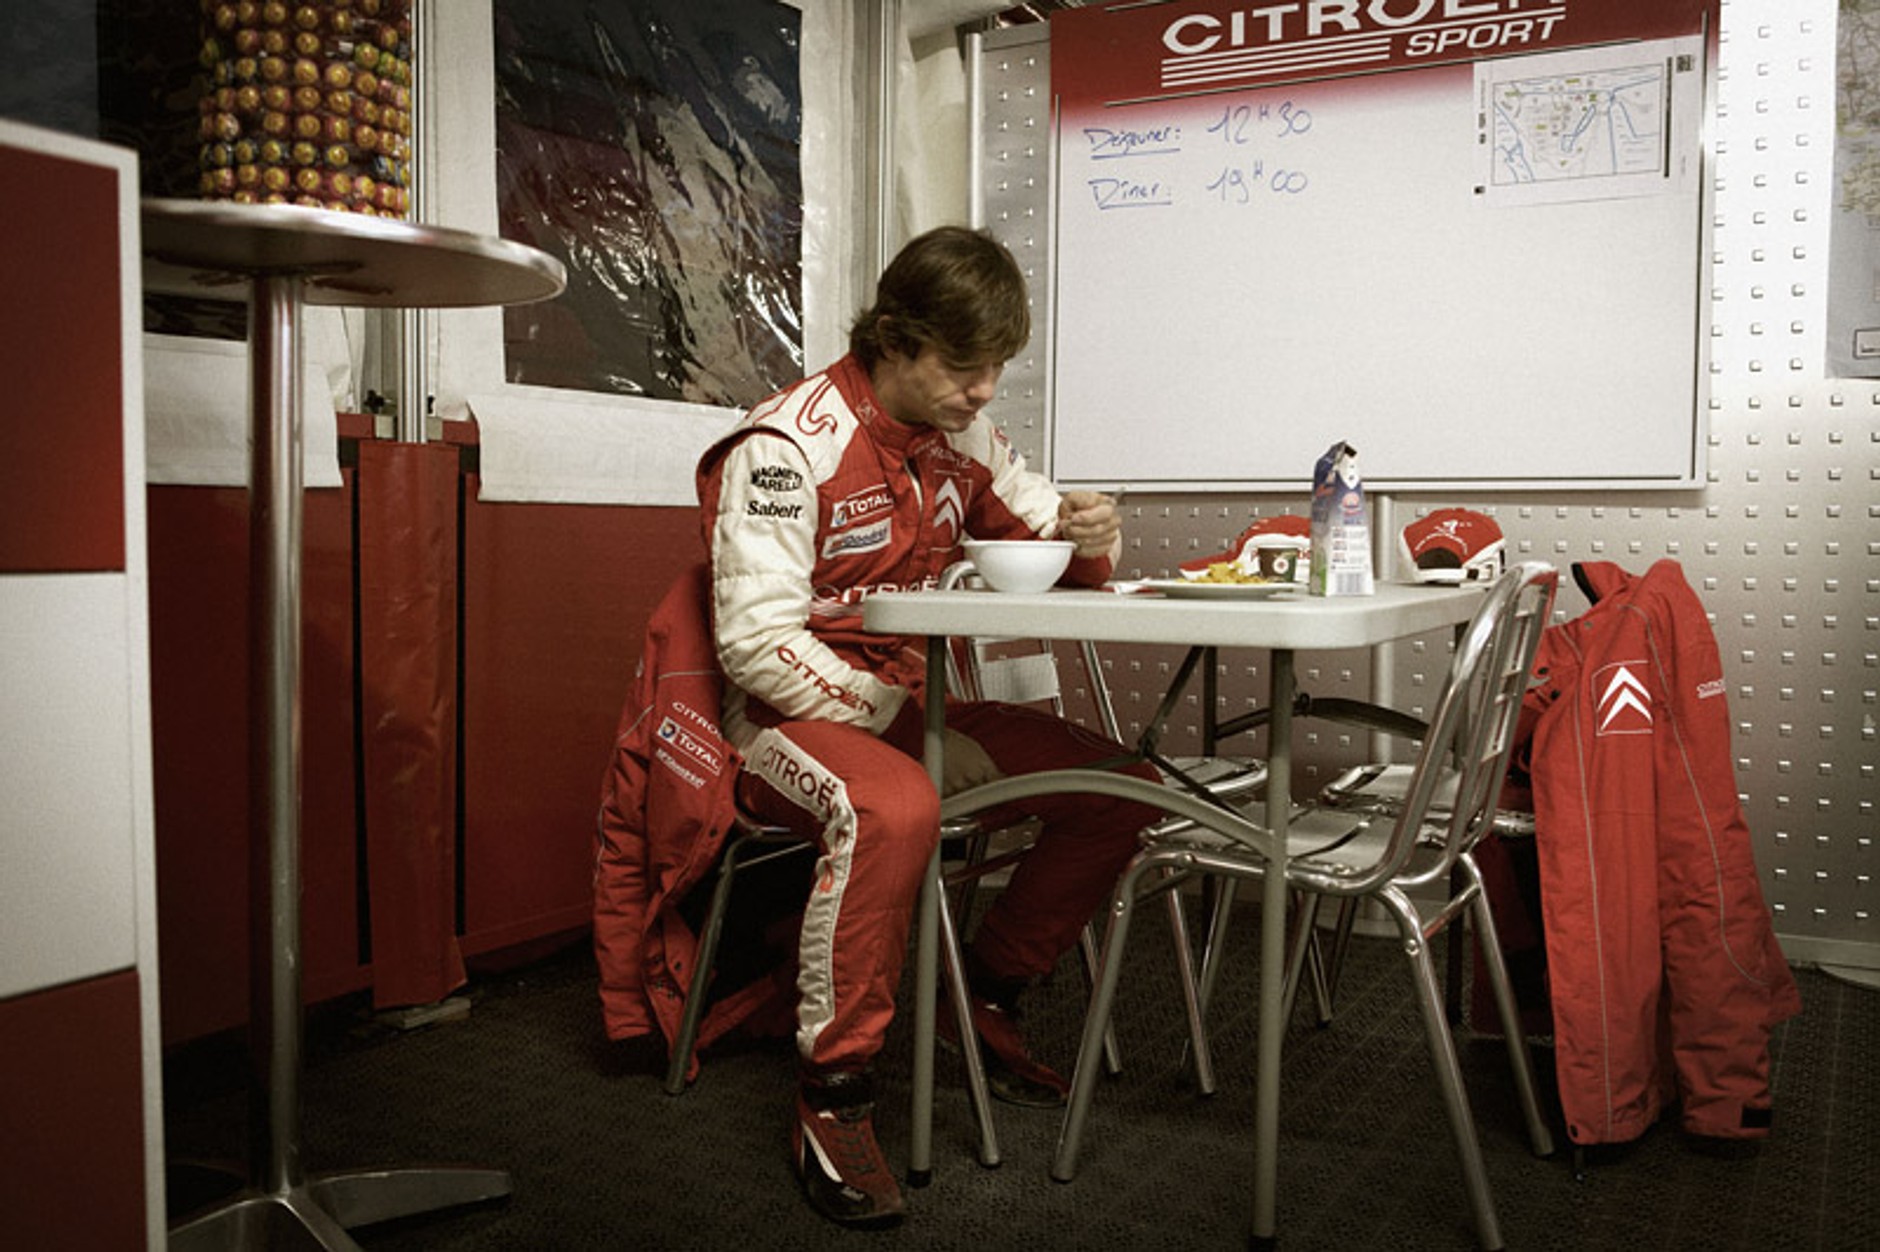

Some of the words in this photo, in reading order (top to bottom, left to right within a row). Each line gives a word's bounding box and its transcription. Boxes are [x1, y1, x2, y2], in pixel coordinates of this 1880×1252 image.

[1405, 15, 1567, 57] SPORT
[847, 493, 894, 516] TOTAL
[680, 732, 719, 770] TOTAL
